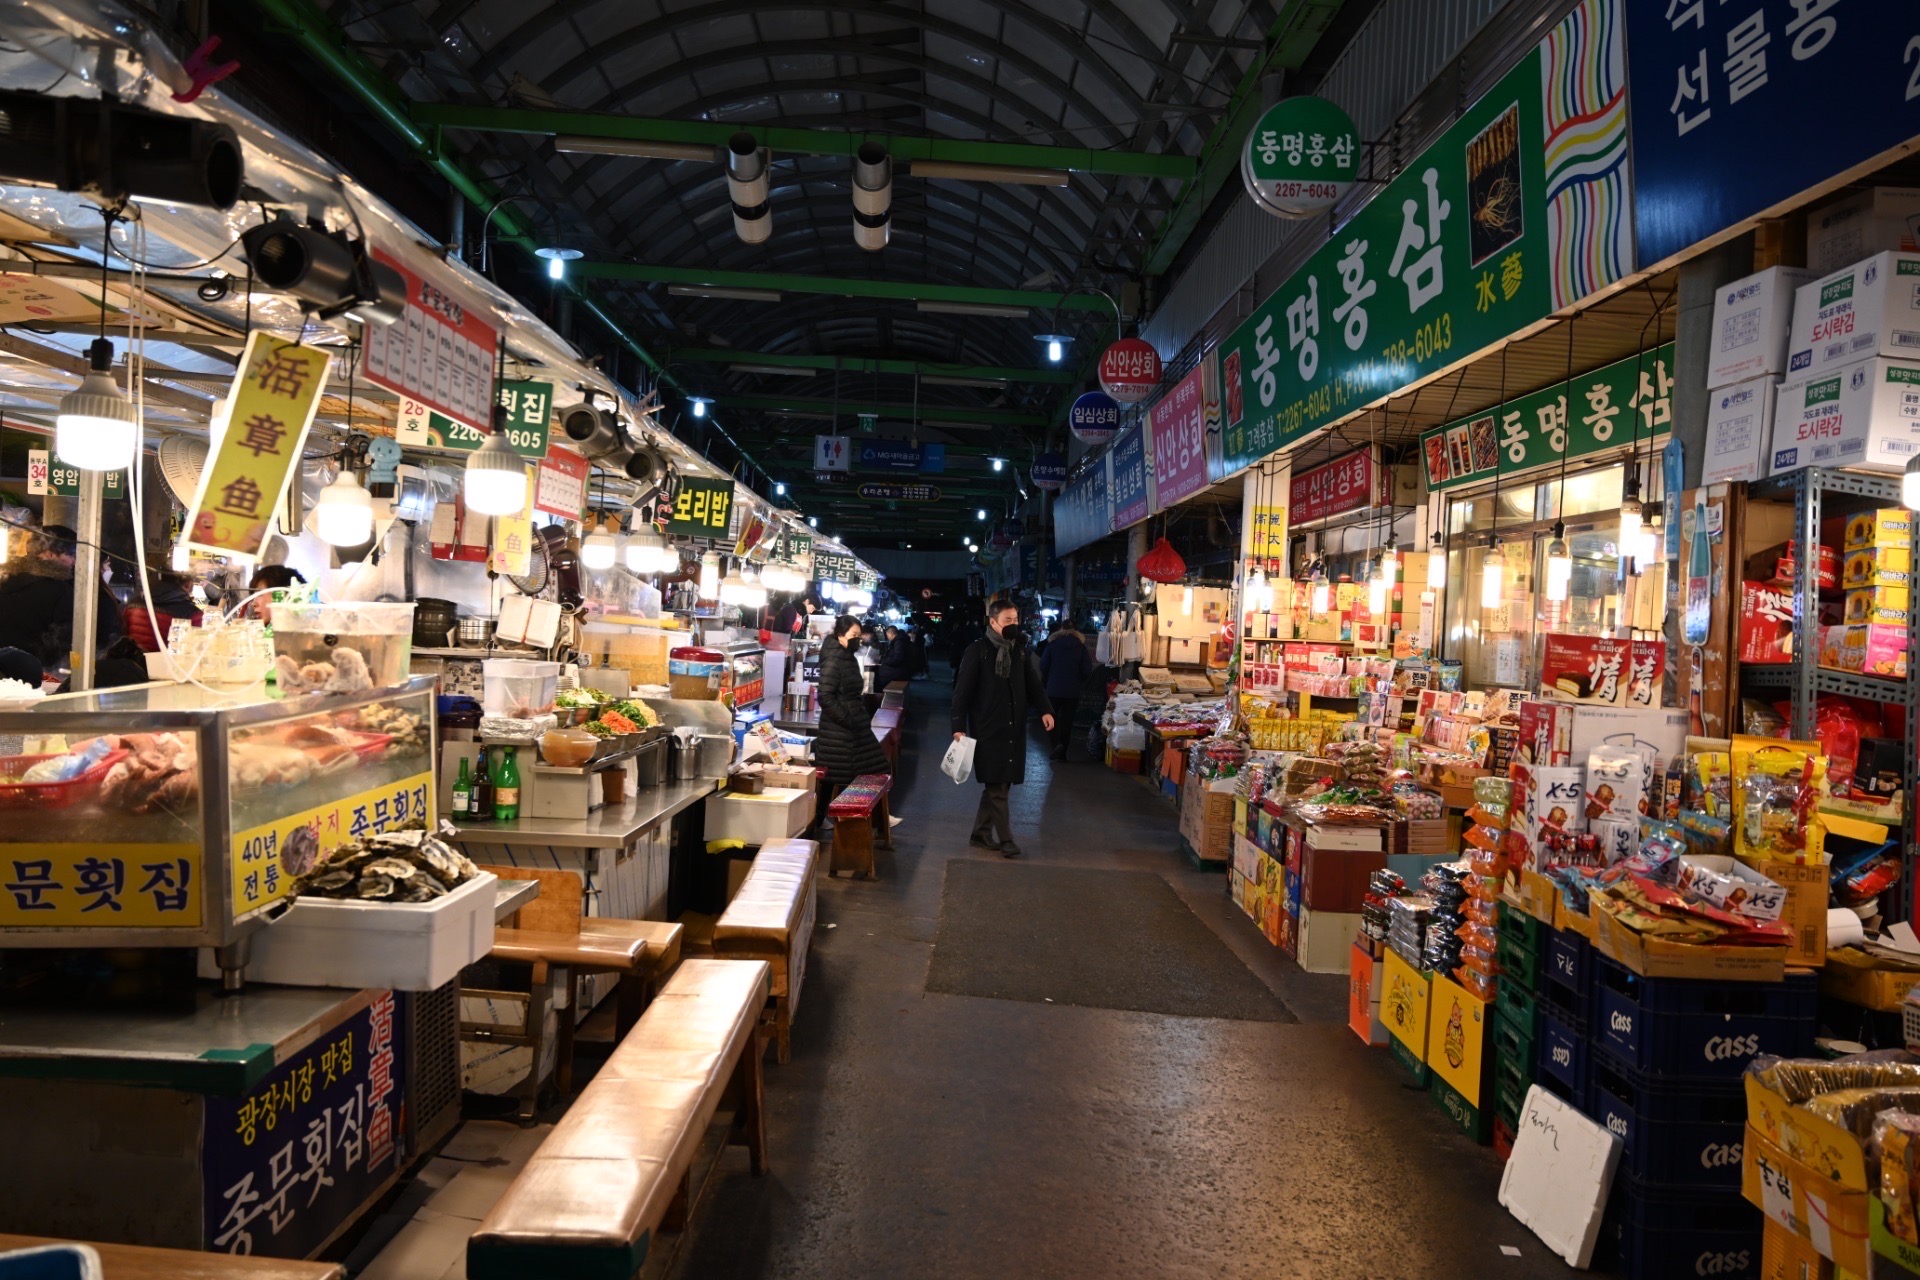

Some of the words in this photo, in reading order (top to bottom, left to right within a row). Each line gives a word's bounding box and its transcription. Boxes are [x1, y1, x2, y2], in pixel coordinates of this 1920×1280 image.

[1669, 8, 1771, 137] 선물
[1256, 130, 1355, 170] 동명홍삼
[1275, 182, 1338, 200] 2267-6043
[1251, 167, 1451, 408] 동명홍삼
[1811, 311, 1856, 343] 도시락김
[1105, 350, 1155, 379] 신안상회
[1790, 350, 1812, 368] 24개입
[1110, 383, 1149, 394] 2279-7014
[405, 418, 420, 431] 호
[1073, 407, 1118, 425] 일심상회
[1500, 359, 1675, 464] 동명홍삼
[1246, 419, 1275, 454] 고려홍삼
[1796, 414, 1843, 442] 도시락김
[1156, 404, 1202, 486] 신안상회
[1775, 449, 1797, 466] 24개입
[31, 465, 47, 479] 34
[33, 479, 43, 488] 호
[1309, 456, 1366, 505] 신안상회
[862, 488, 891, 497] 우리은행
[673, 489, 729, 528] 보리밥
[815, 555, 855, 572] 전라도
[818, 568, 851, 583] 횟집
[855, 571, 878, 583] 라도
[1590, 643, 1624, 654] 초코파이
[1588, 653, 1624, 703] 情
[1545, 781, 1582, 799] X-5
[1642, 762, 1651, 797] X-5
[307, 808, 340, 841] 낙지
[242, 830, 277, 863] 40년
[1616, 828, 1629, 858] X-5
[4, 857, 191, 913] 문횟집
[243, 863, 280, 902] 전통
[1692, 874, 1718, 896] X-5
[1746, 892, 1780, 909] X-5
[1610, 1009, 1632, 1034] Cass
[1552, 1046, 1570, 1068] Cass
[1703, 1032, 1760, 1063] Cass
[235, 1058, 316, 1147] 광장시장
[320, 1031, 354, 1091] 맛집
[1606, 1110, 1628, 1138] Cass
[213, 1082, 364, 1257] 종문횟집
[1700, 1141, 1744, 1170] Cas
[1695, 1248, 1752, 1278] Cass
